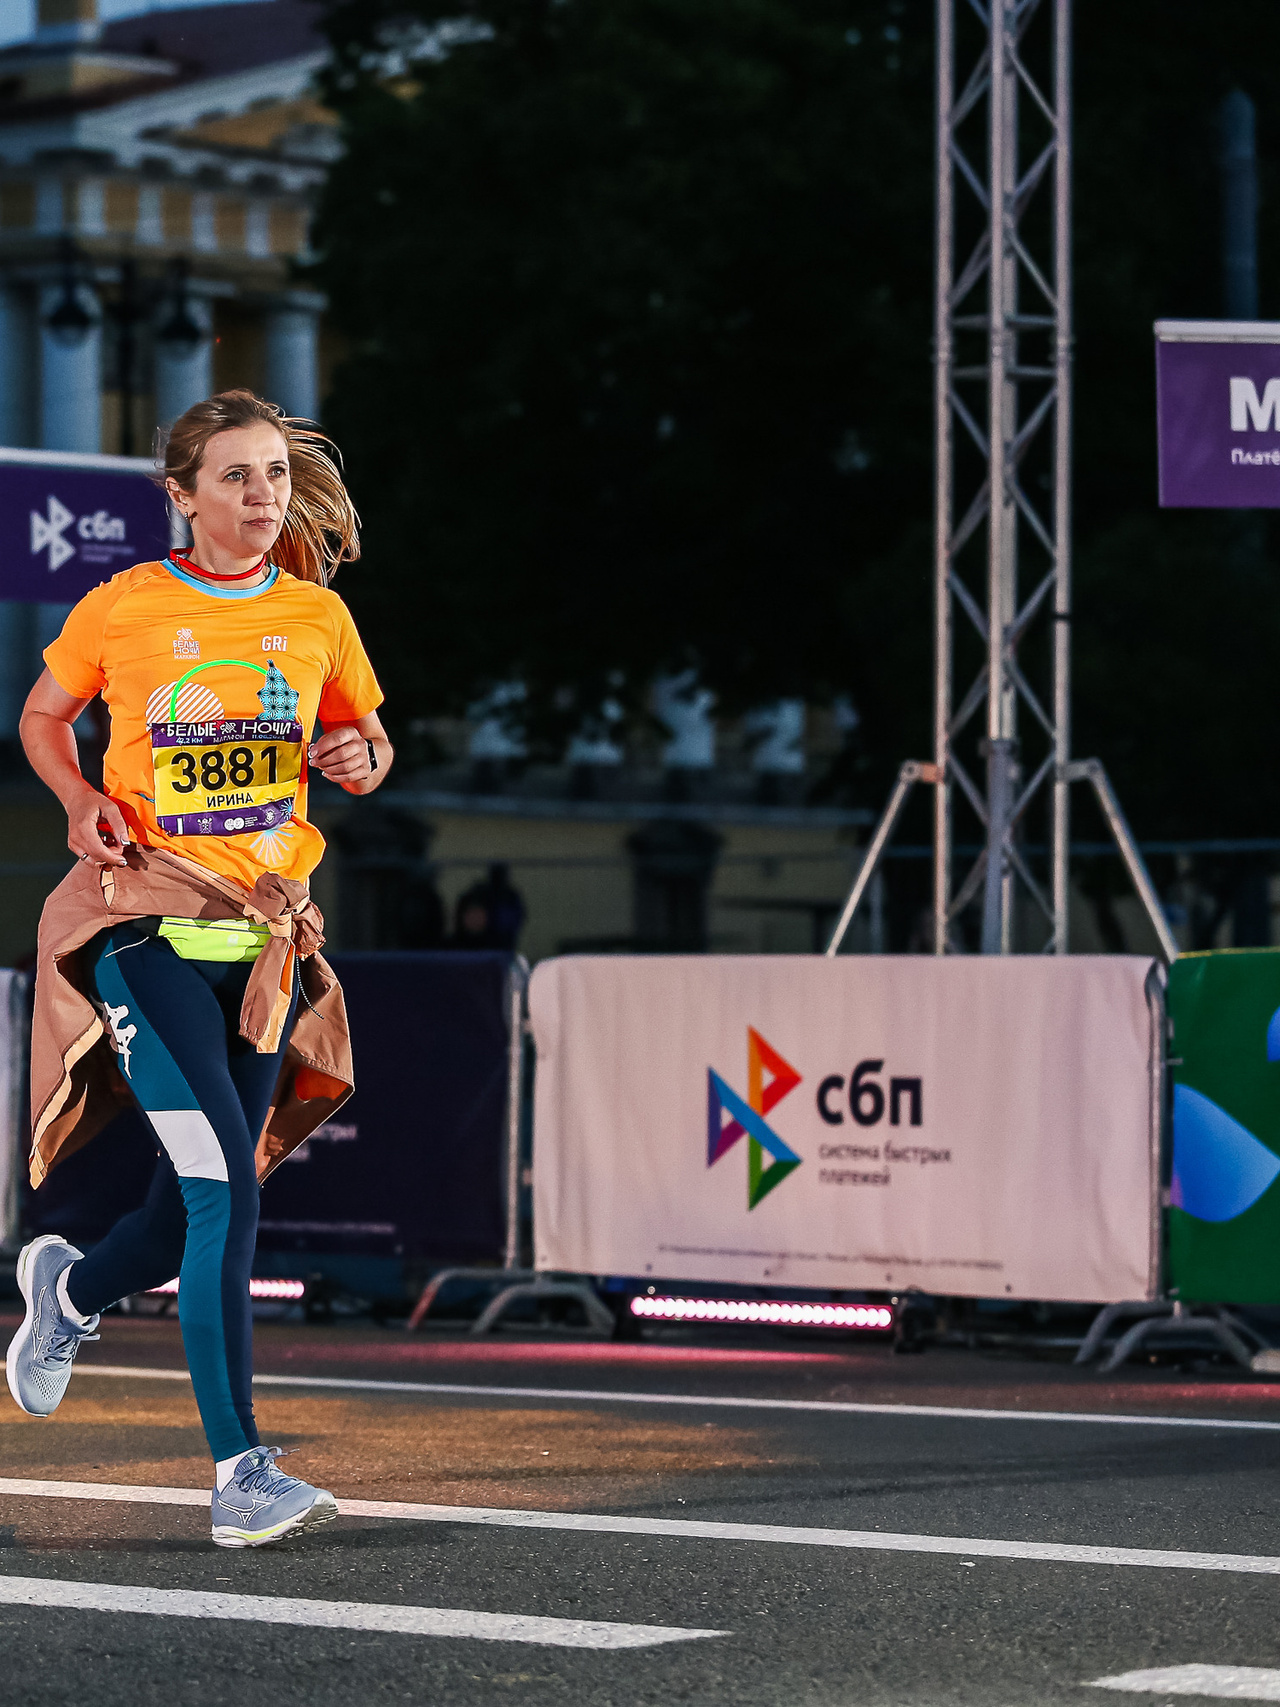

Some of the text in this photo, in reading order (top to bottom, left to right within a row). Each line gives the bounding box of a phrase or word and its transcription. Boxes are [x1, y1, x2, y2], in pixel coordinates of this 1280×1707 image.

[173, 640, 200, 648] БЕЛЫЕ
[173, 647, 200, 655] НОЧИ
[166, 721, 292, 737] БЕЛЫЕ НОЧИ
[171, 745, 278, 794] 3881
[206, 792, 254, 808] ИРИНА
